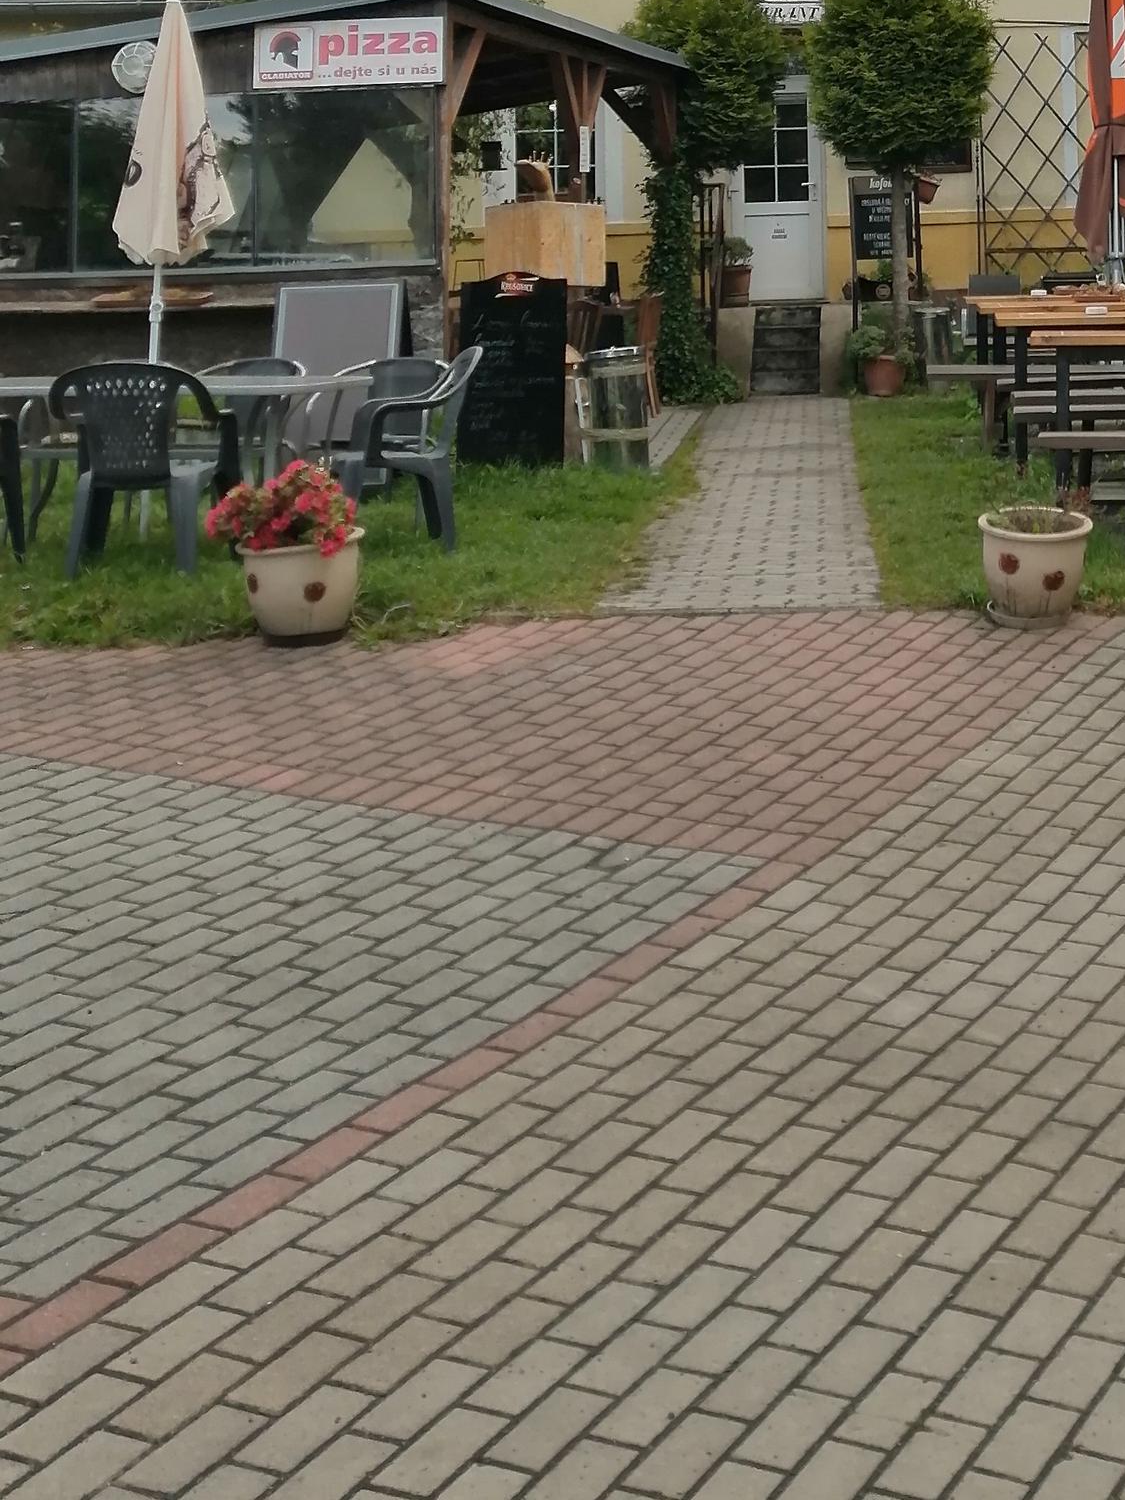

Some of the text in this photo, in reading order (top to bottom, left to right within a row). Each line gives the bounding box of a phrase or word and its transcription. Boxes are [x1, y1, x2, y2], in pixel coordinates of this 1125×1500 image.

[318, 24, 438, 66] pizza
[377, 64, 390, 77] si
[396, 66, 406, 76] u
[411, 62, 438, 76] nás
